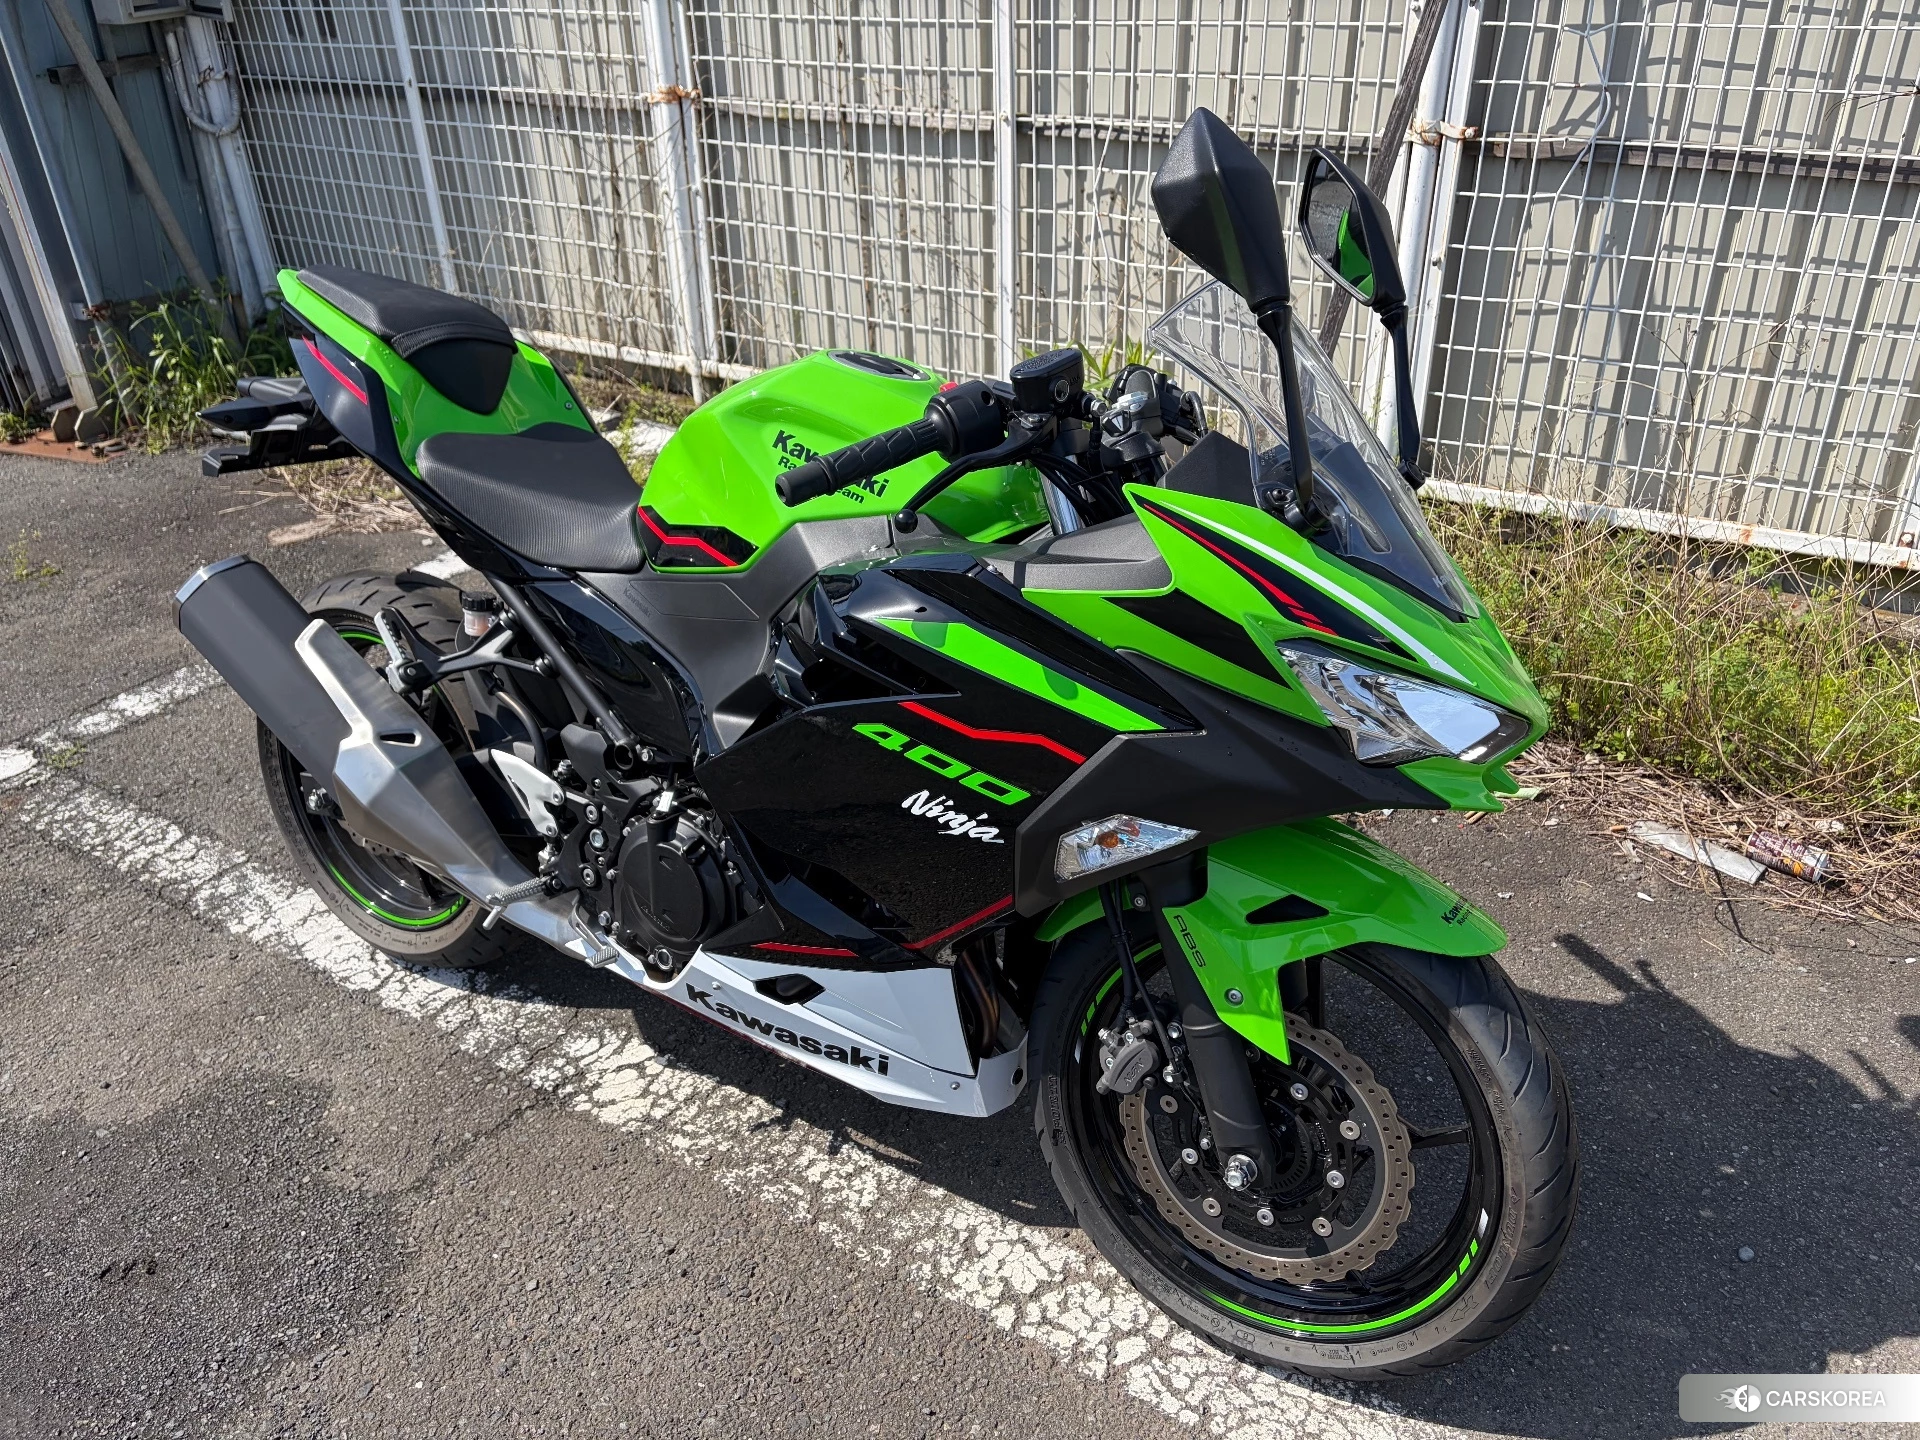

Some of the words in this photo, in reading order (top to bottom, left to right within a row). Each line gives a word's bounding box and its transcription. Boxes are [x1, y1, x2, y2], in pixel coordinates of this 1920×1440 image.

[852, 723, 1031, 805] 400
[901, 789, 1005, 844] Ninja
[1173, 914, 1207, 968] ABS
[686, 982, 890, 1077] Kawasaki
